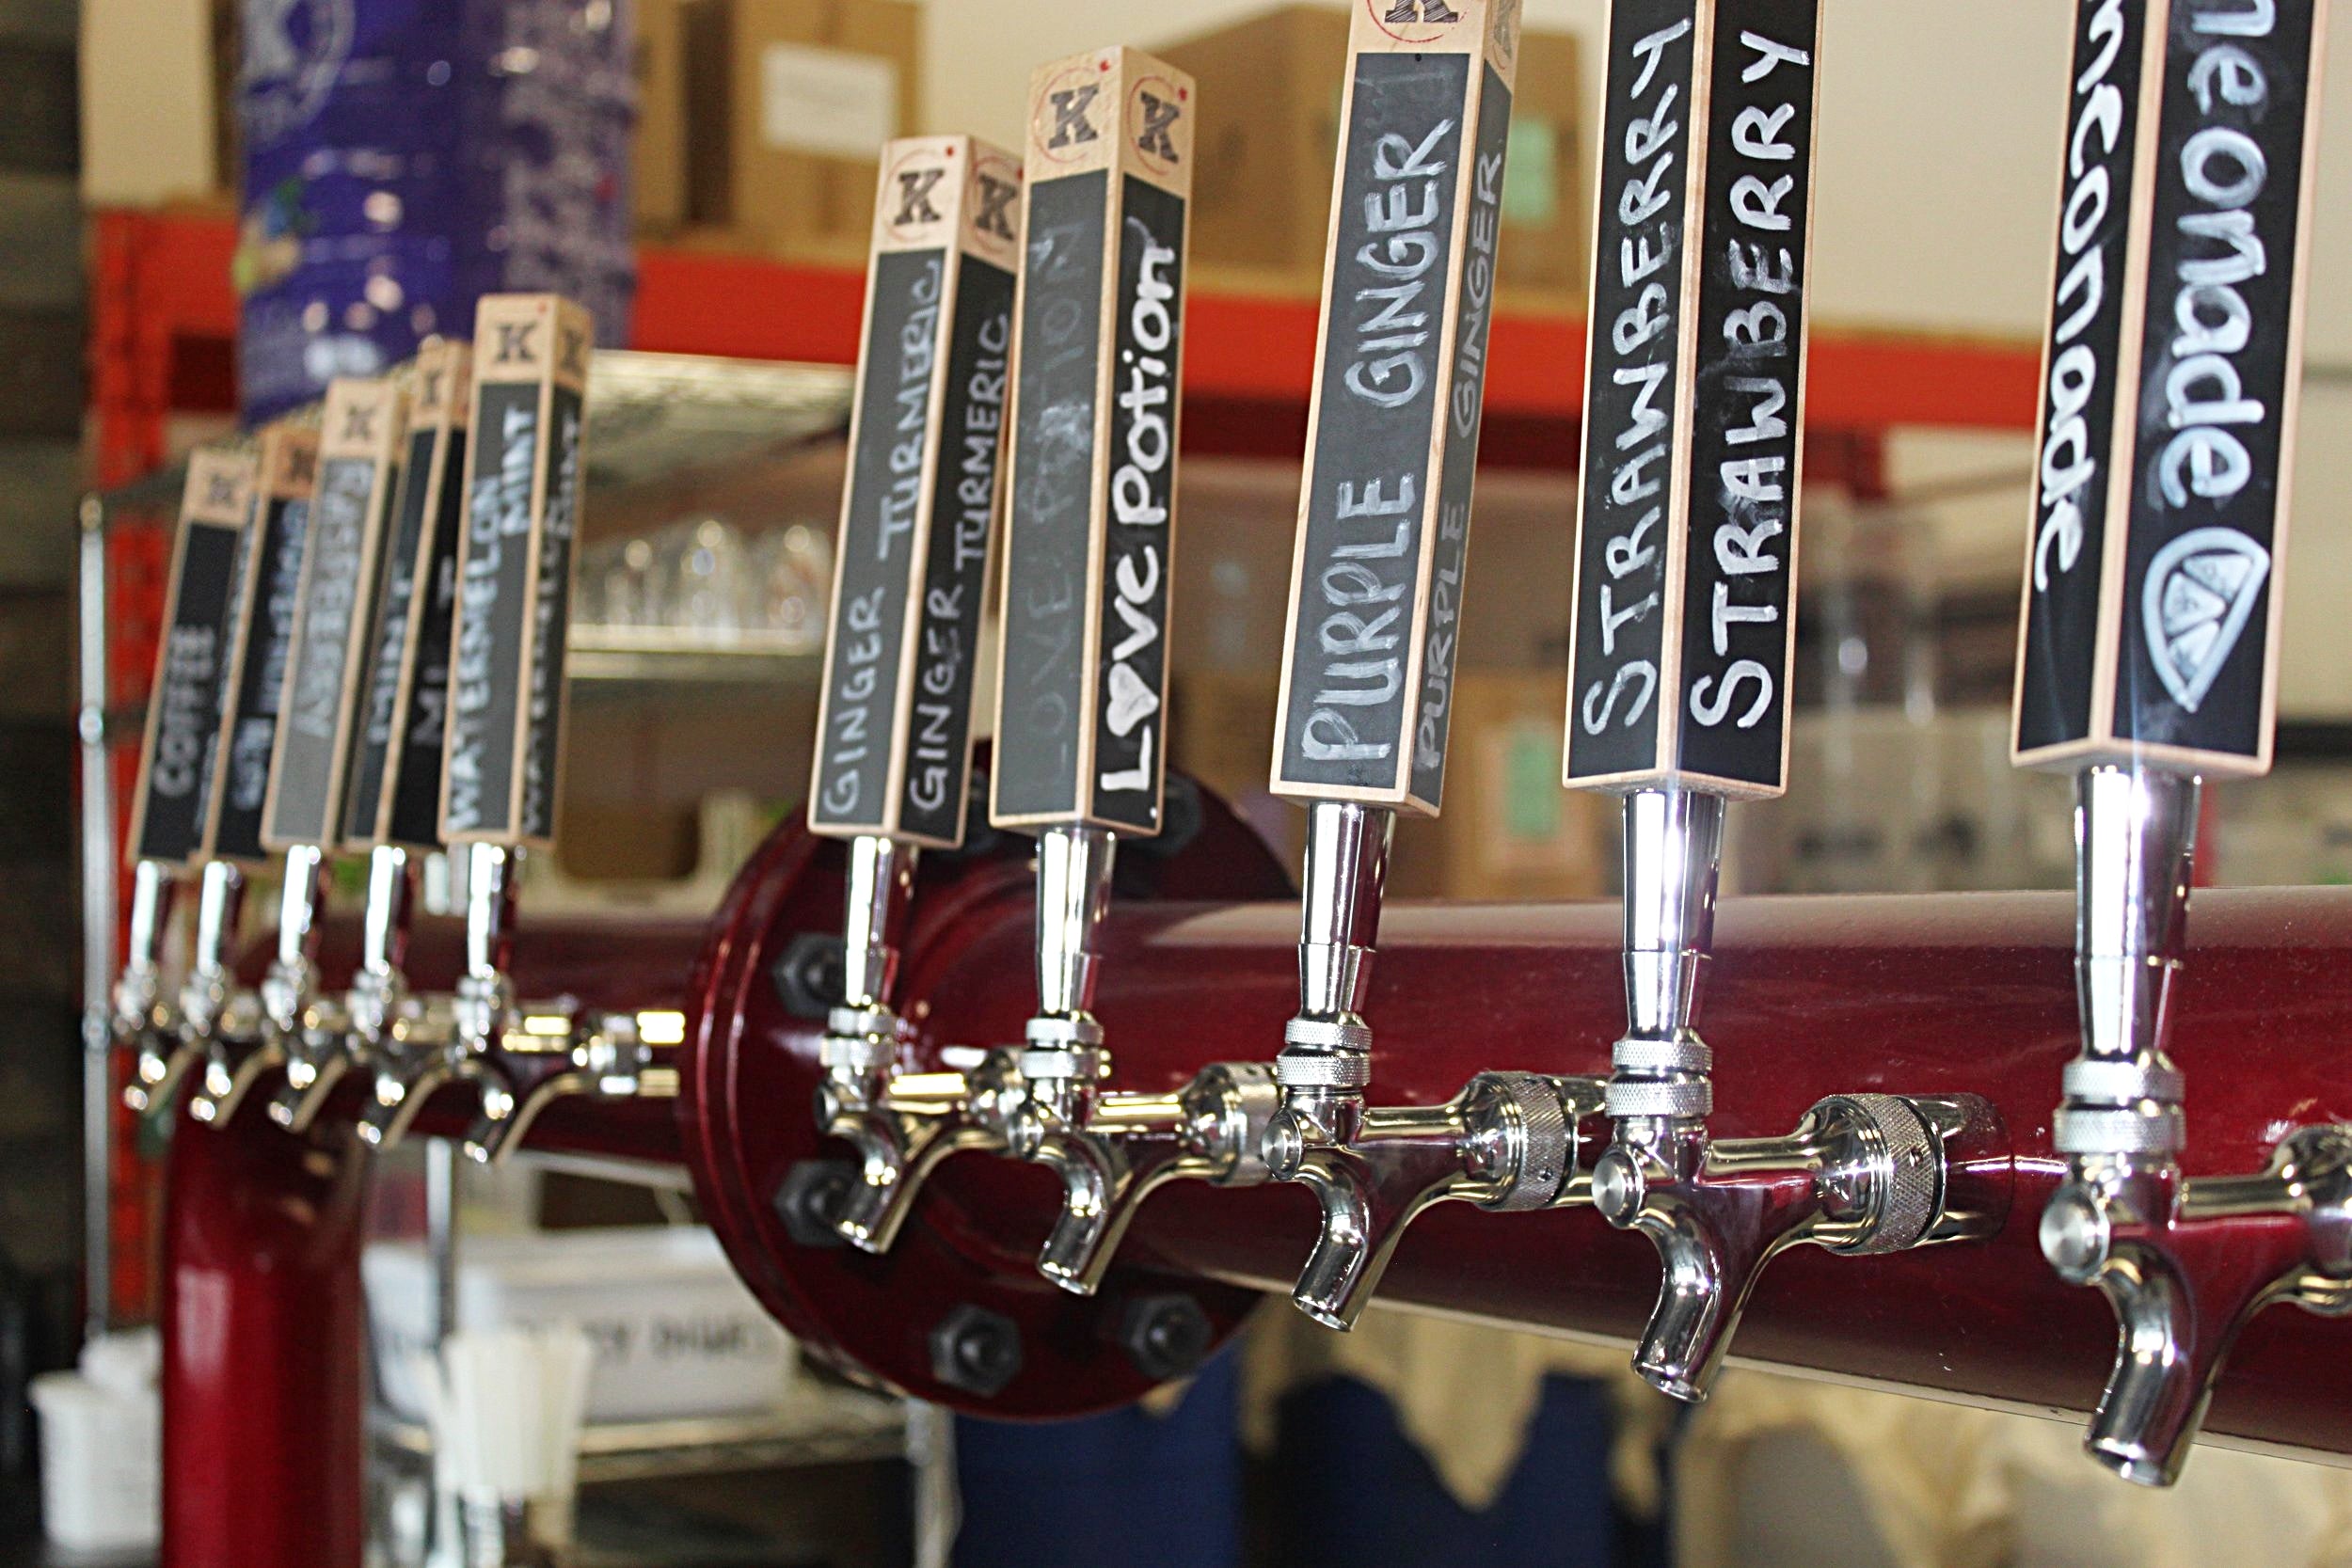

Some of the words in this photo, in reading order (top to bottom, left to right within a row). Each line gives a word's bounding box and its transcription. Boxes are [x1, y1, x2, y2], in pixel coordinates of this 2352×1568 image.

[895, 169, 944, 225] K
[976, 173, 1016, 240] K
[1048, 83, 1099, 150] K
[1138, 90, 1180, 164] K
[495, 321, 536, 362] K
[1344, 118, 1456, 408] GINGER
[1583, 17, 1692, 736] STRAWBERRY
[501, 403, 535, 537] MINT
[1416, 502, 1466, 770] PURPLE
[1453, 151, 1502, 438] GINGER
[1690, 29, 1810, 729] STRAWBERRY
[911, 583, 963, 814] GINGER
[953, 312, 1009, 569] TURMERIC
[1302, 472, 1416, 761] PURPLE
[824, 585, 885, 816] GINGER
